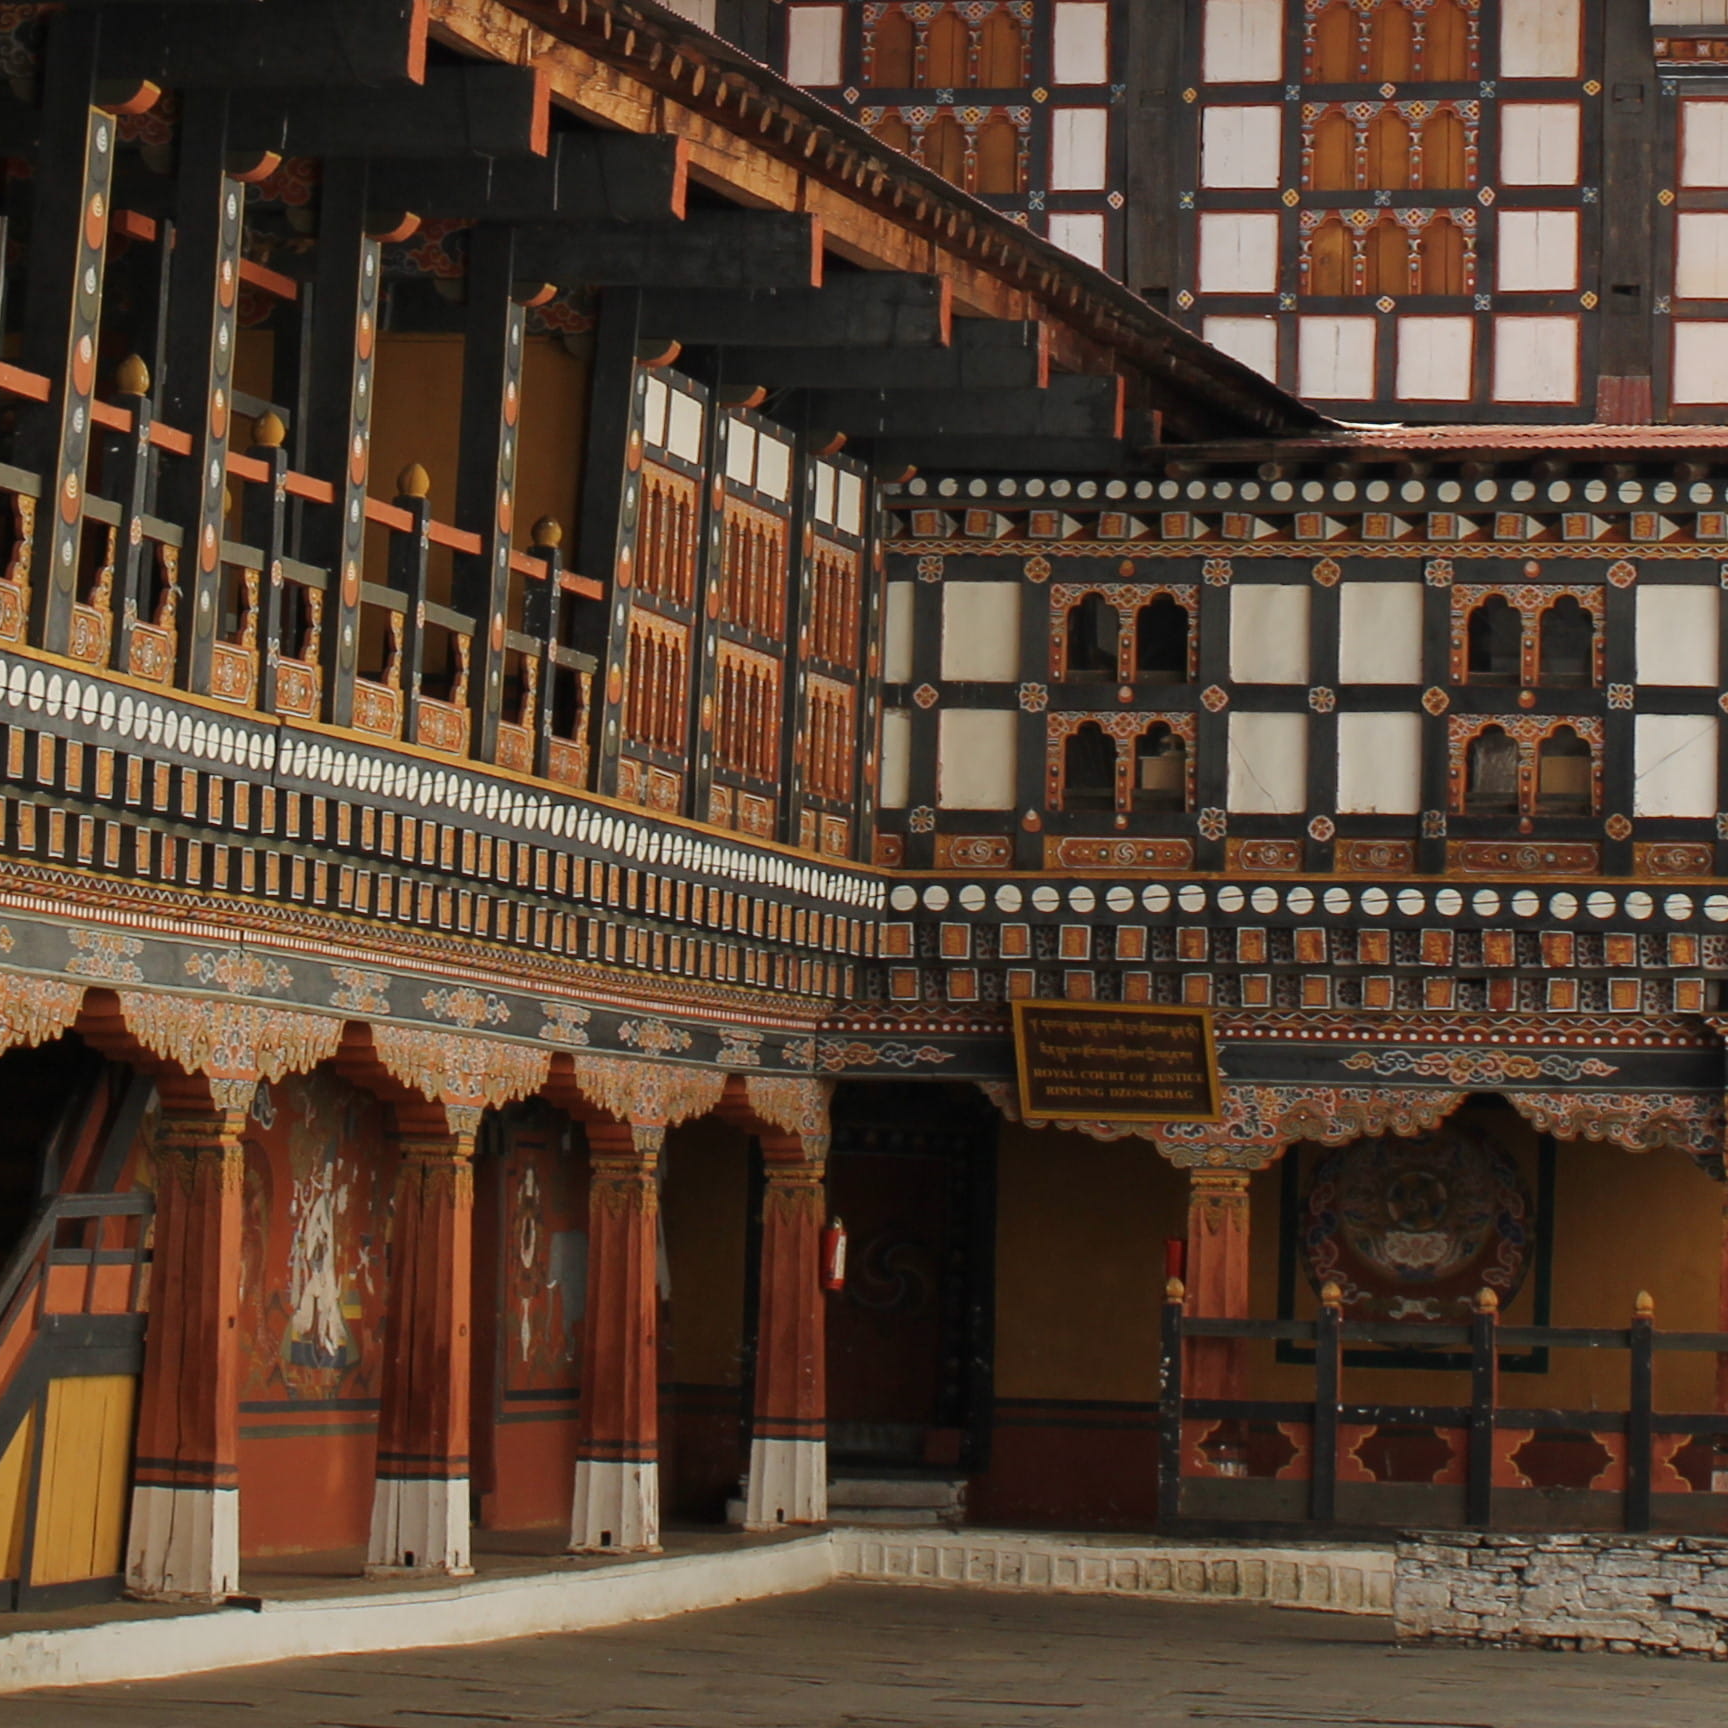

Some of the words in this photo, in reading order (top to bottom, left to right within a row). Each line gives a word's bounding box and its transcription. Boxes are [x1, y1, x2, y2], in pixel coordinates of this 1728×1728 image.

[1033, 1068, 1075, 1079] ROYAL
[1080, 1070, 1125, 1081] COURT
[1129, 1072, 1146, 1082] OF
[1152, 1073, 1204, 1083] JUSTICE
[1046, 1085, 1104, 1097] RINPUNG
[1109, 1088, 1193, 1100] DZONGKHAG
